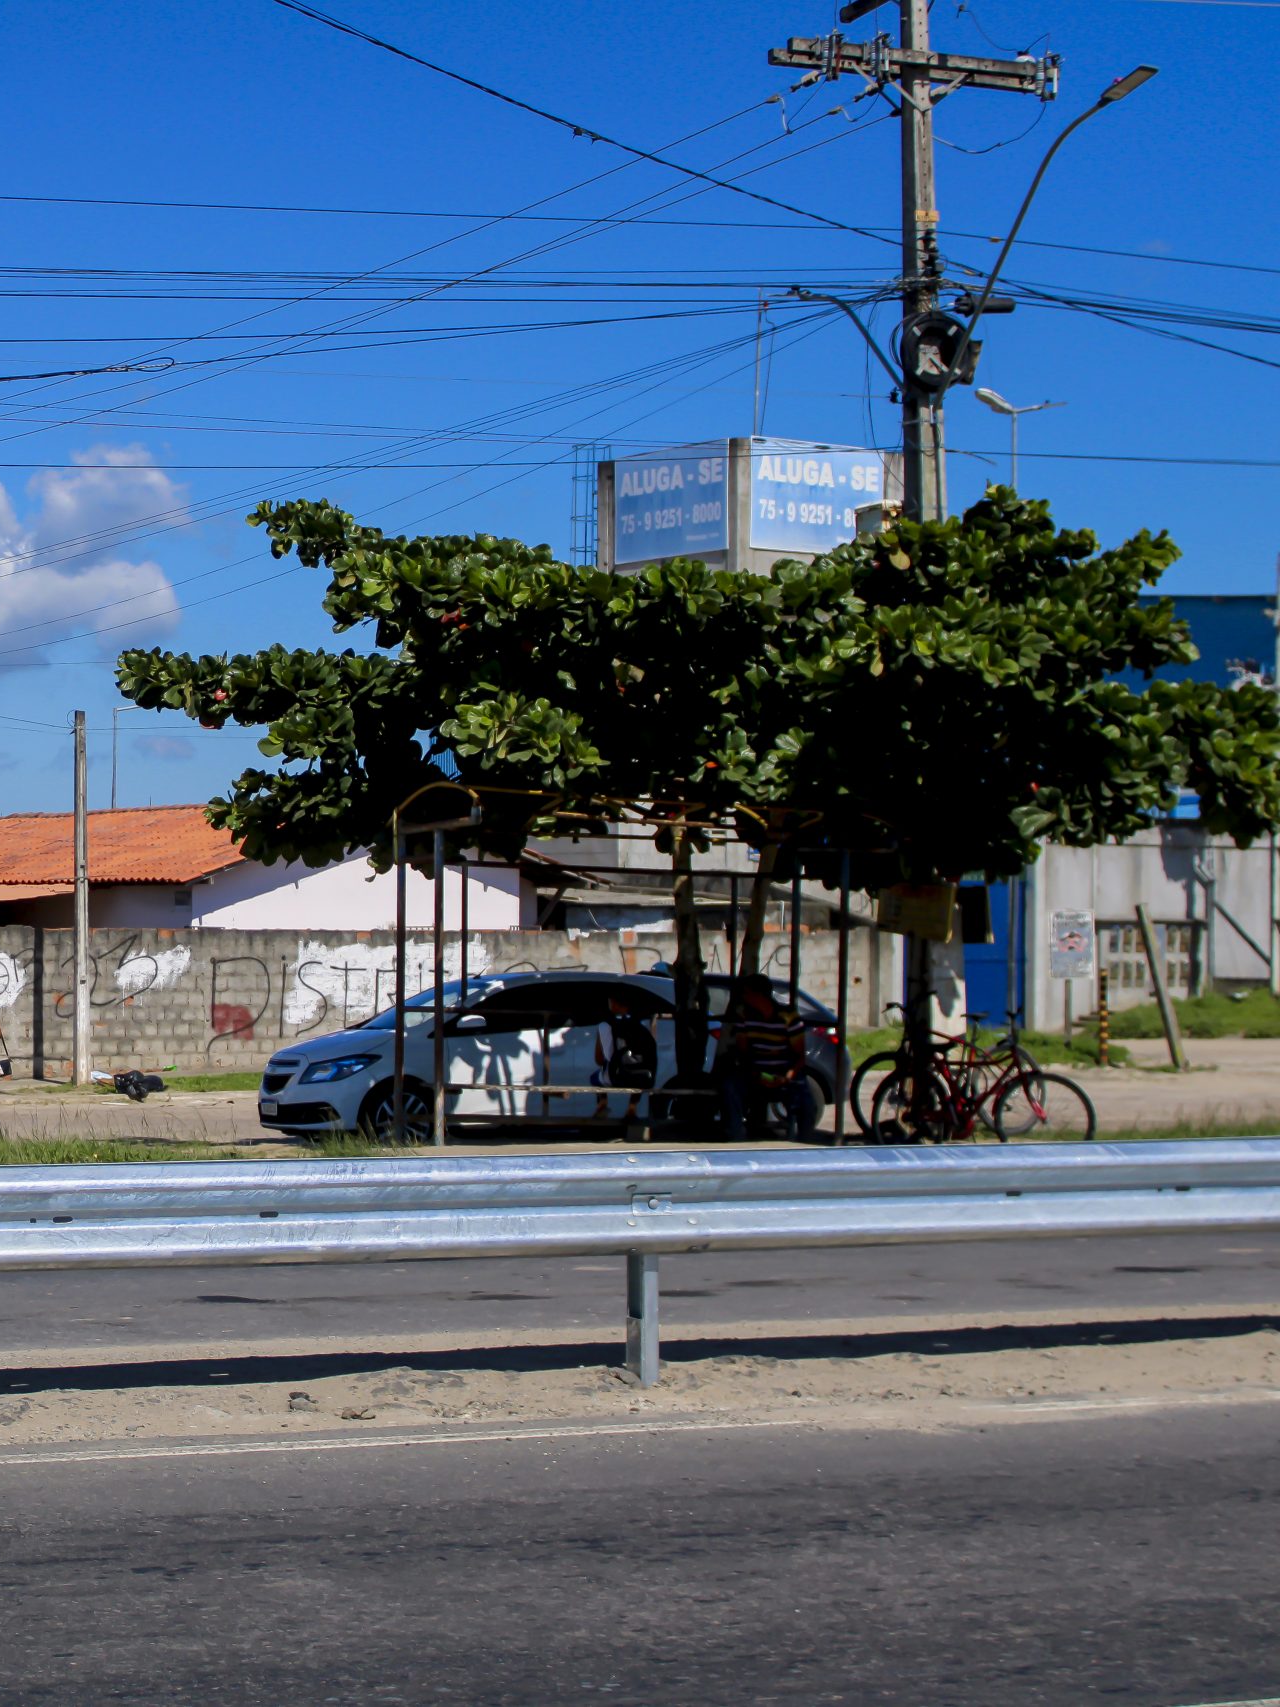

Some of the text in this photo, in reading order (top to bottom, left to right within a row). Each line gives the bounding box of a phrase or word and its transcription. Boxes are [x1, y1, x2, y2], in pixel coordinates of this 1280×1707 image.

[620, 464, 684, 497] ALUGA
[698, 457, 723, 485] SE
[757, 455, 835, 488] ALUGA
[851, 465, 880, 492] SE
[621, 514, 635, 535] 75
[644, 511, 652, 531] 9
[655, 507, 683, 530] 9251
[692, 501, 722, 524] 8000
[759, 498, 776, 520] 75
[787, 501, 796, 522] 9
[800, 502, 833, 526] 9251
